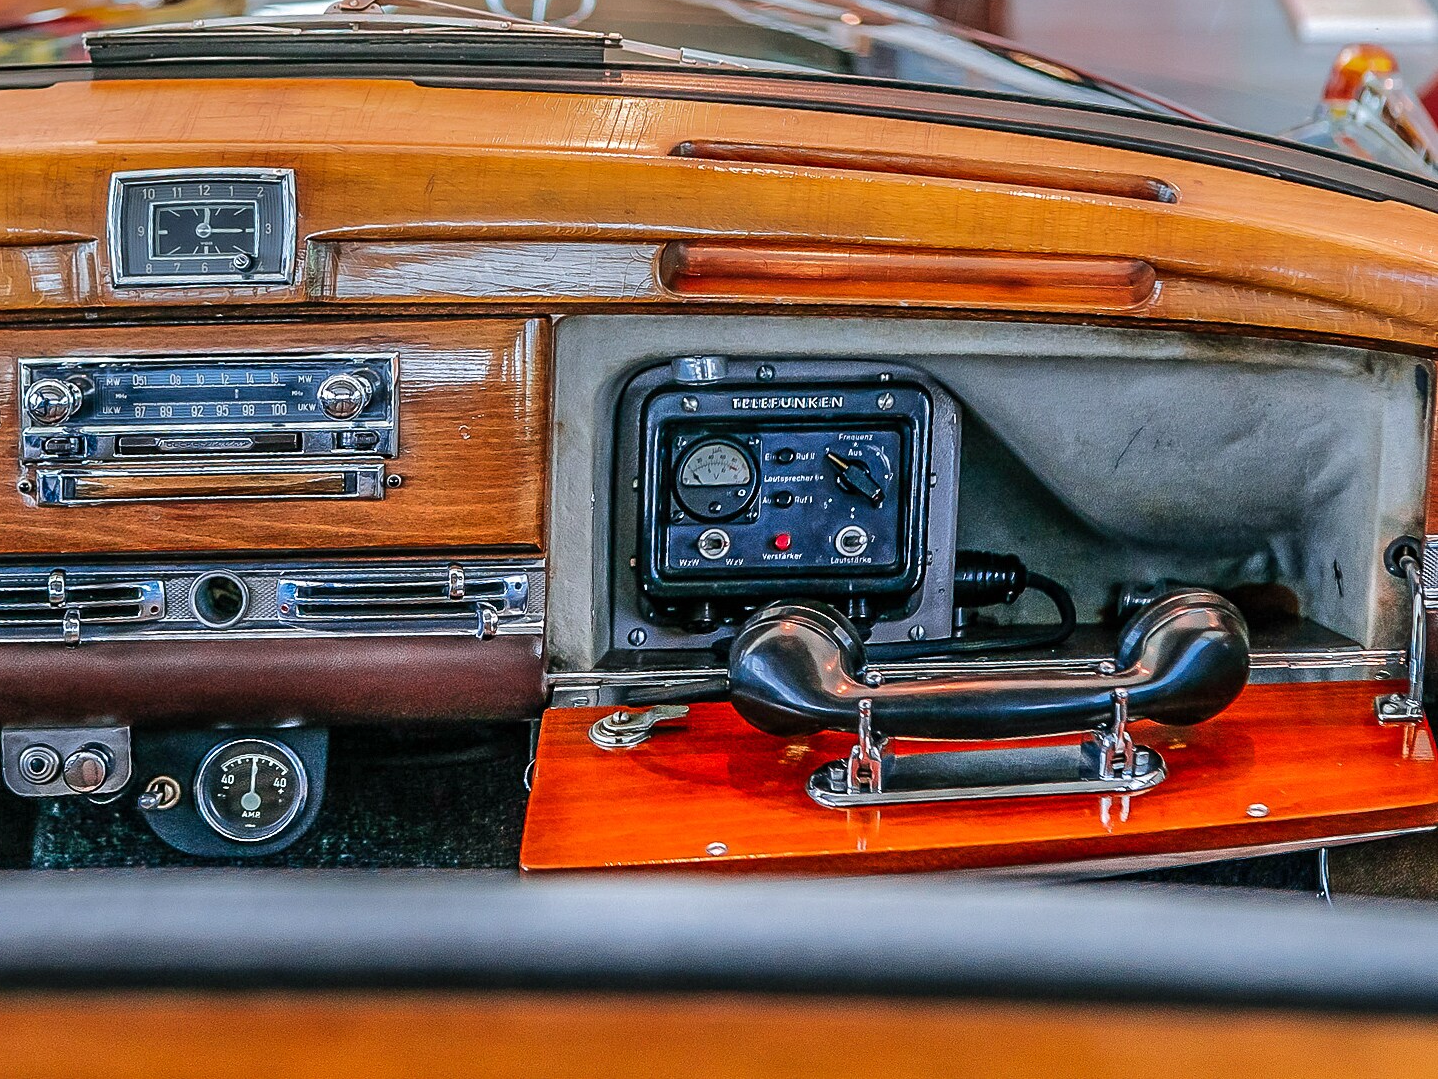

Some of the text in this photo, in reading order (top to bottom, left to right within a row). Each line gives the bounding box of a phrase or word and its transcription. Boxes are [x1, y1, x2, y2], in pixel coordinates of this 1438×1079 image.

[142, 184, 264, 200] 10 11 12 1 2
[137, 223, 272, 237] 9 3
[145, 261, 264, 274] 8 7 6 5 4
[106, 378, 121, 386] MW
[170, 374, 182, 384] 08
[196, 374, 205, 384] 10
[221, 373, 230, 384] 12
[246, 372, 254, 384] 14
[270, 372, 279, 384] 16
[298, 375, 312, 383] MW
[732, 396, 844, 409] TELEFUNKEN
[102, 403, 316, 418] UKW 87 89 92 95 98 100 UKW
[838, 433, 873, 442] Frequenz
[764, 452, 776, 460] Ein
[796, 452, 809, 460] Ruf
[848, 448, 862, 456] Aus
[764, 474, 814, 483] Lautsprecher
[794, 496, 808, 504] Ruf
[762, 552, 802, 560] Verstärker
[830, 556, 872, 564] Lautstärke
[220, 774, 287, 788] 40 40
